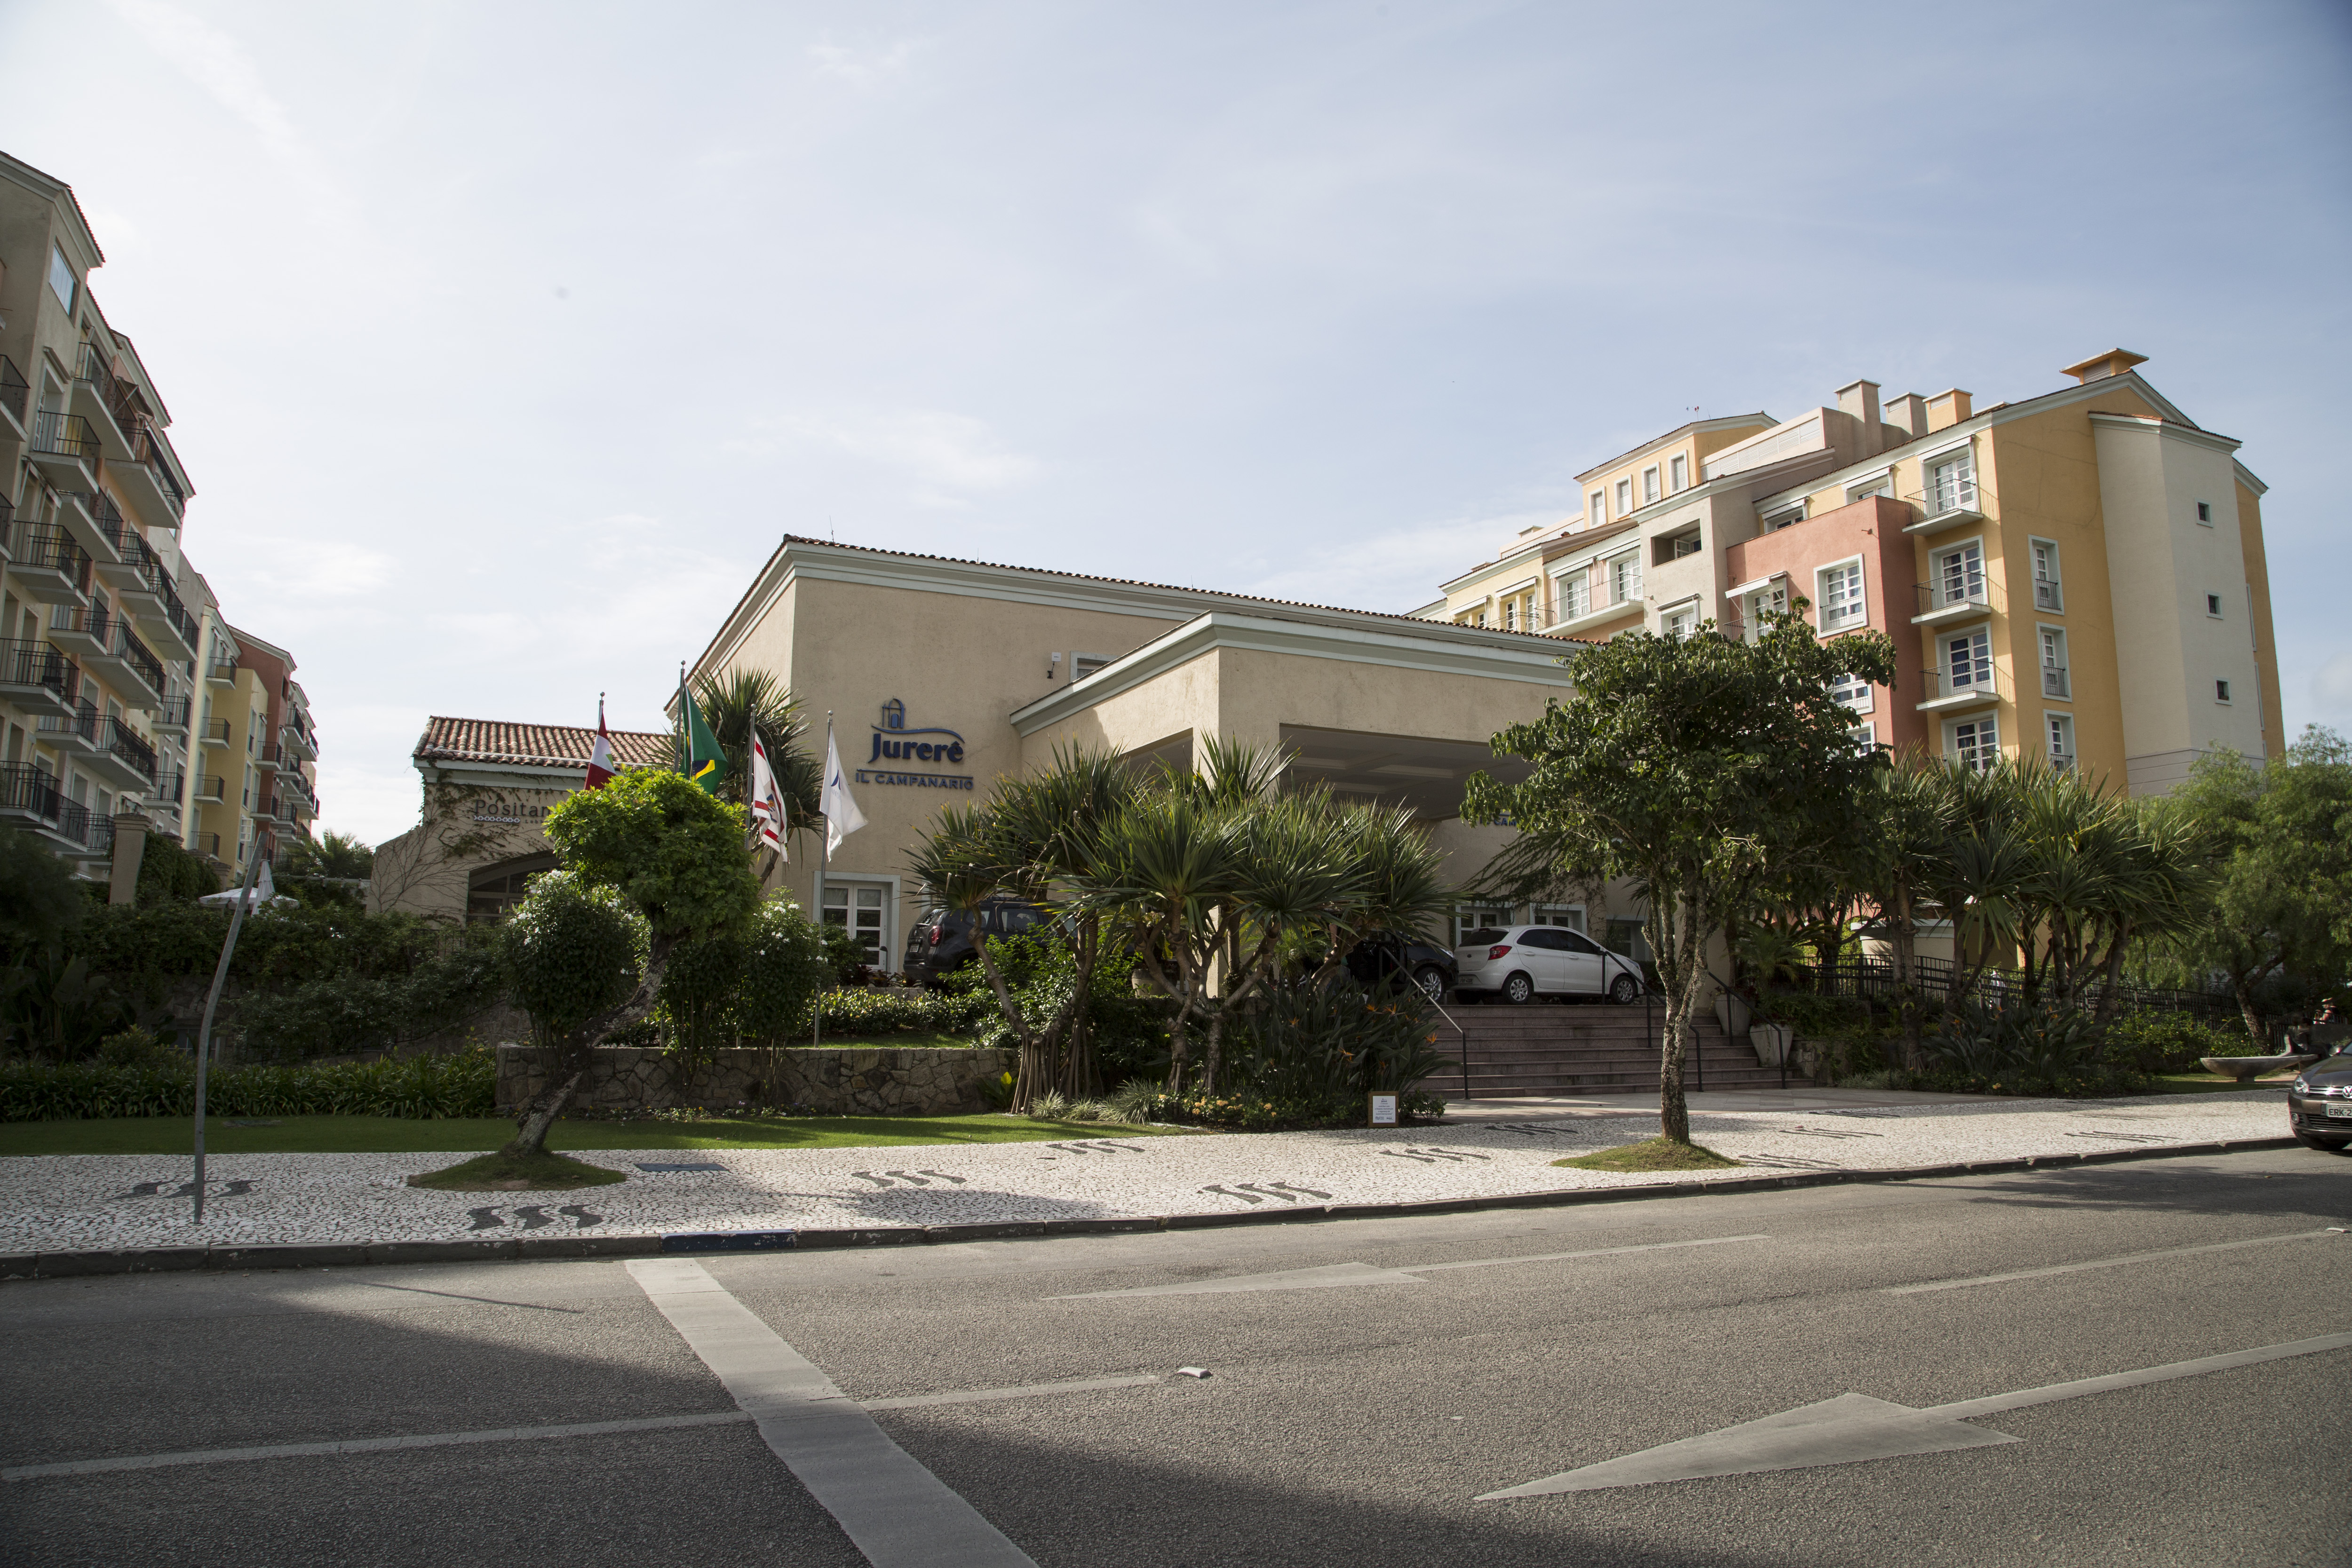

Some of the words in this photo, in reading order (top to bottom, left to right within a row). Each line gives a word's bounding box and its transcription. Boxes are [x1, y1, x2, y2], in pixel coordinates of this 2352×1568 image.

[868, 733, 964, 763] Jurerê
[856, 772, 870, 783] IL
[875, 774, 974, 789] CAMPANARIO
